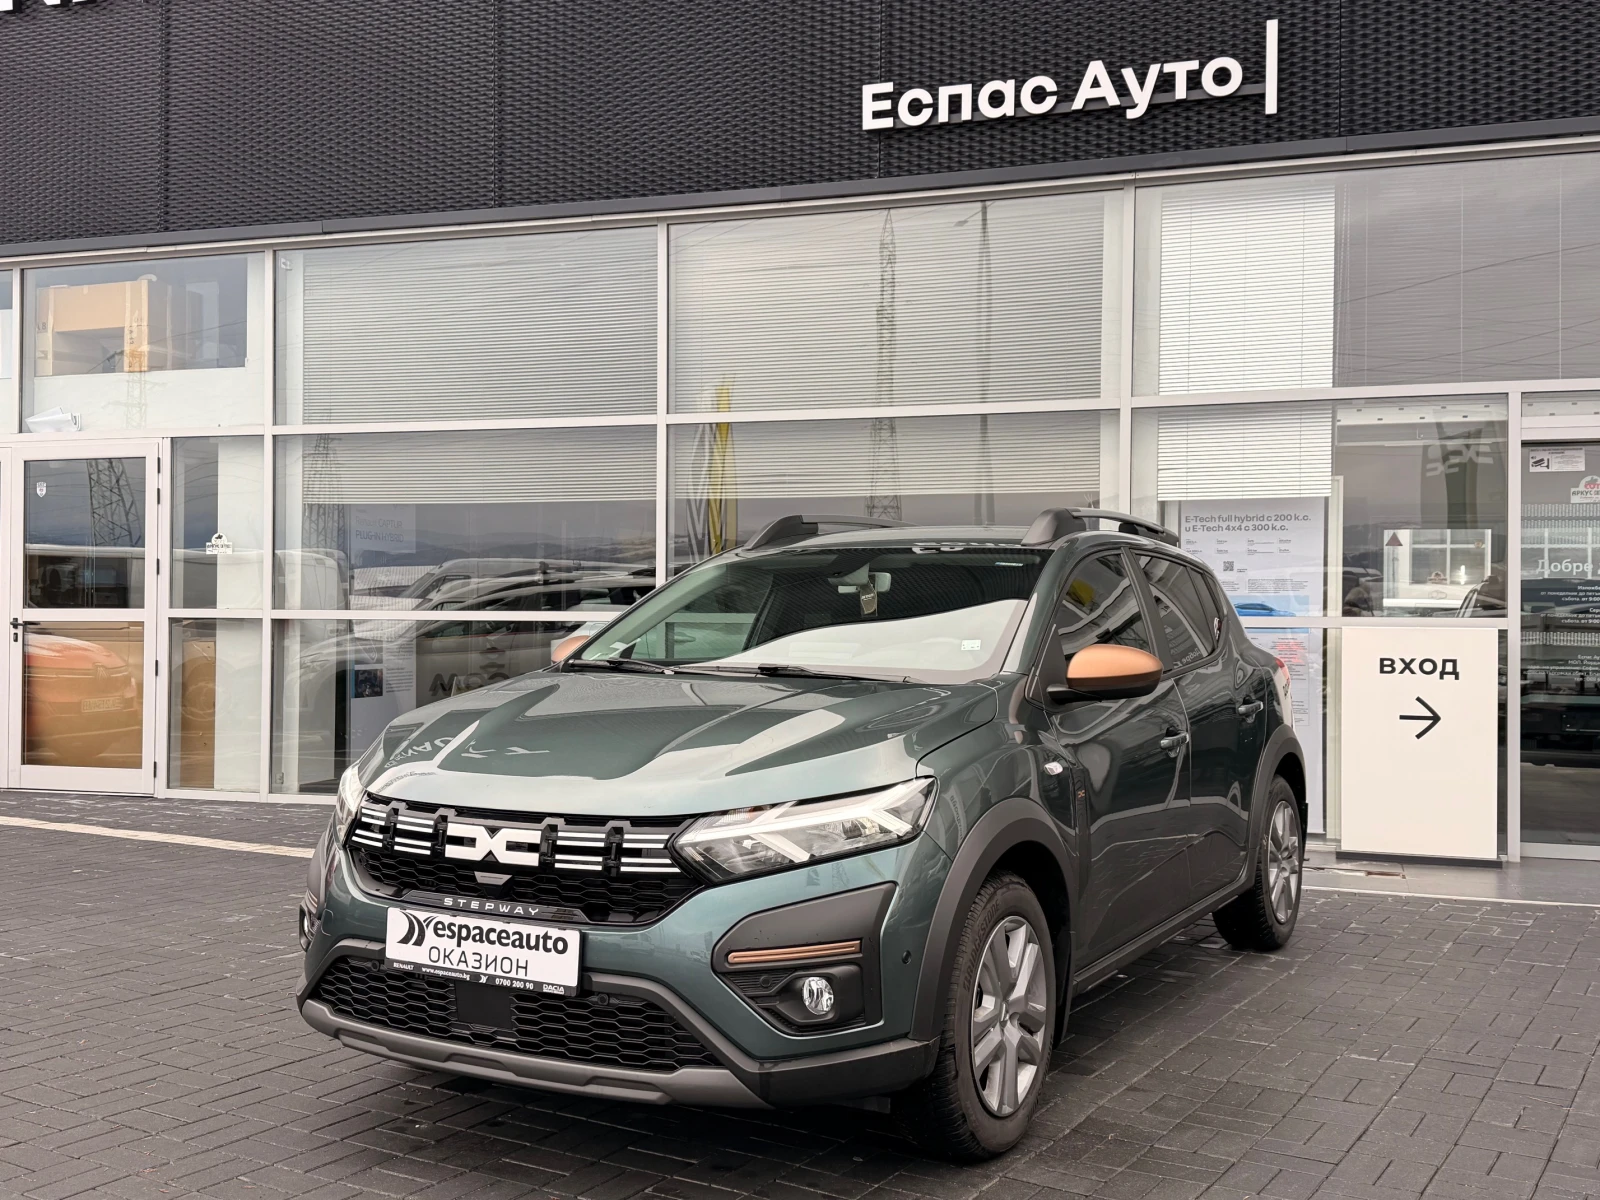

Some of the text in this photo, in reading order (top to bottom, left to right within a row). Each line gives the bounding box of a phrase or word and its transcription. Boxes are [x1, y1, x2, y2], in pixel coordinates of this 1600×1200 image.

[862, 57, 1243, 131] Еспас Ауто
[1185, 515, 1216, 523] E-Tech
[1217, 514, 1232, 522] full
[1234, 513, 1264, 523] hybrid
[1274, 513, 1292, 521] 200
[1192, 524, 1223, 532] E-Tech
[1251, 523, 1270, 531] 300
[1536, 559, 1593, 575] Добре
[444, 897, 539, 916] STEPWAY
[433, 920, 569, 955] espaceauto
[428, 946, 528, 977] ОКАЗИОН
[393, 962, 415, 971] RENAULT
[495, 977, 511, 987] 0700
[512, 980, 525, 989] 200
[526, 982, 534, 990] 90
[543, 984, 564, 992] DACIA
